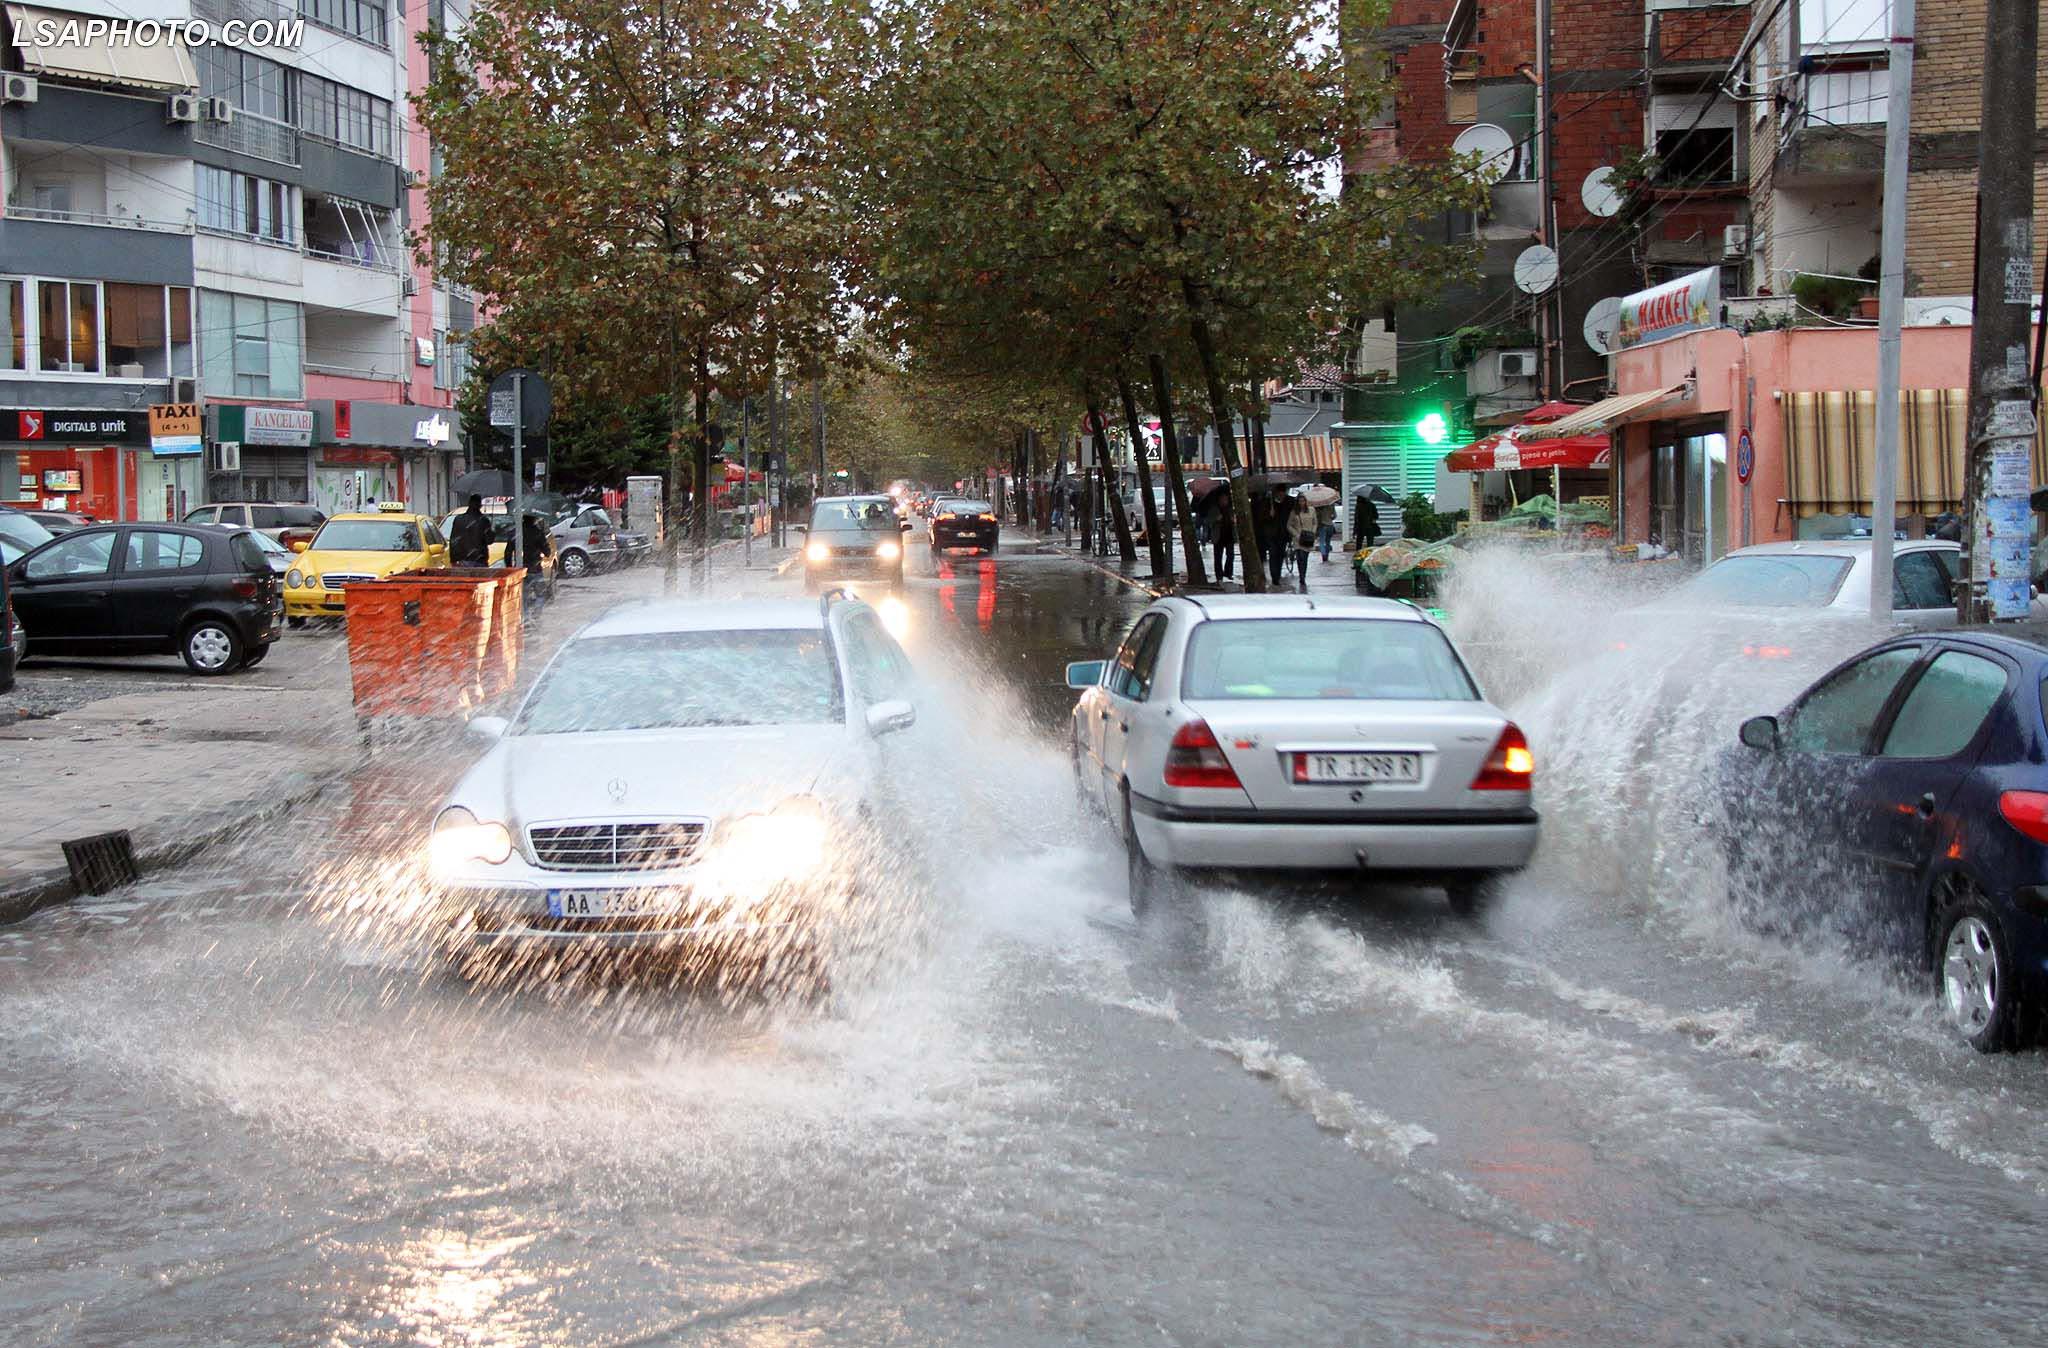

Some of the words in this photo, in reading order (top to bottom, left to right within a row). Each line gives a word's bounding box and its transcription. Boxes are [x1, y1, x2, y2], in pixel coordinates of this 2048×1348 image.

[1639, 285, 1690, 332] MARKET
[153, 405, 197, 418] TAXI
[255, 412, 312, 429] KANCELARI
[54, 422, 97, 432] DIGITALB
[101, 420, 127, 432] unit
[1315, 756, 1338, 777] TR
[1400, 756, 1412, 776] R
[567, 894, 590, 914] AA
